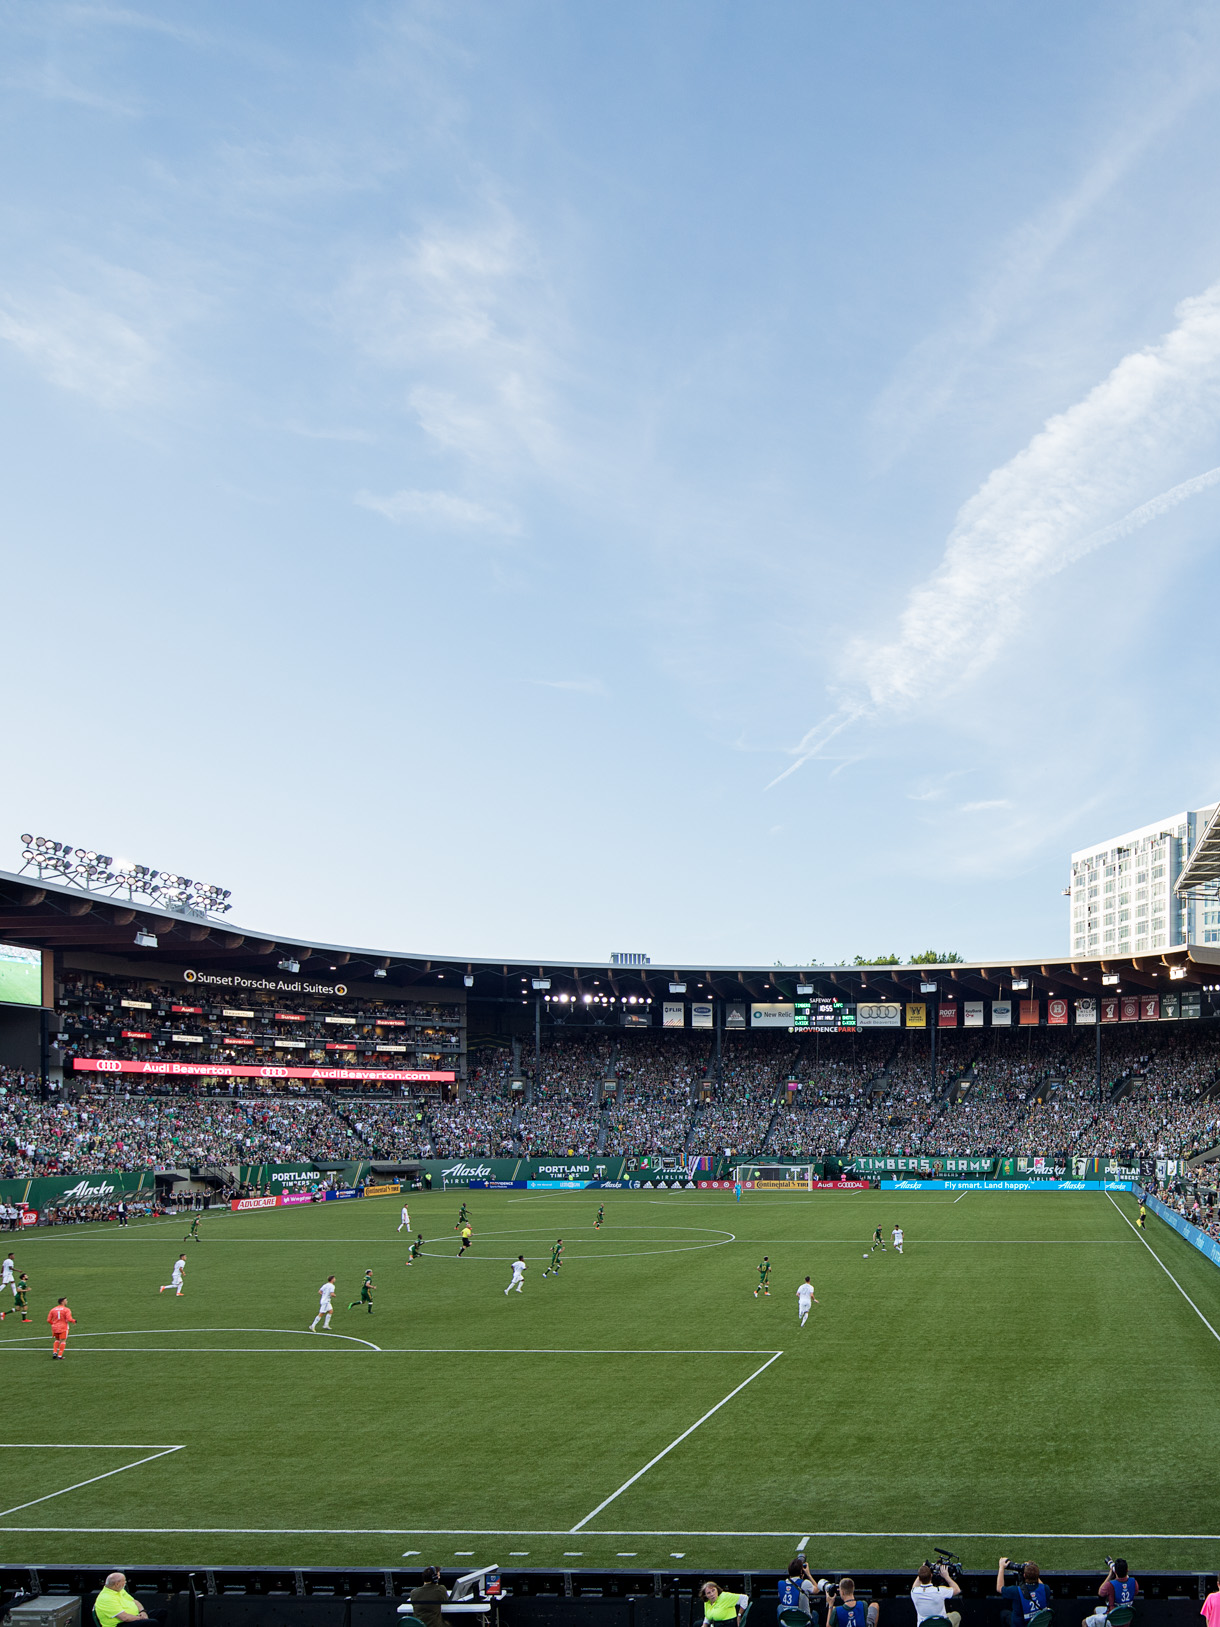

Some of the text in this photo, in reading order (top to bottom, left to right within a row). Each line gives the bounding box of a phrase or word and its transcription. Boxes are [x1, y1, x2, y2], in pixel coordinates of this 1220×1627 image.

[198, 972, 334, 994] Sunset Porsche Audi Suites
[778, 1010, 792, 1018] Relic
[142, 1063, 232, 1074] Audi Beaverton
[312, 1069, 430, 1080] AudiBeaverton.com
[858, 1158, 929, 1170] TIMBERS
[946, 1160, 990, 1171] ARMY
[441, 1163, 492, 1177] Alaska
[272, 1171, 320, 1182] PORTLAND
[64, 1180, 114, 1196] Alaska
[895, 1181, 922, 1189] Alaska
[944, 1182, 956, 1190] Fly
[1058, 1181, 1086, 1189] Alaska
[1105, 1181, 1126, 1189] Alaska
[366, 1187, 388, 1196] Continental
[238, 1196, 276, 1210] ADVOCARE
[783, 1594, 792, 1604] 43
[1121, 1592, 1130, 1602] 32
